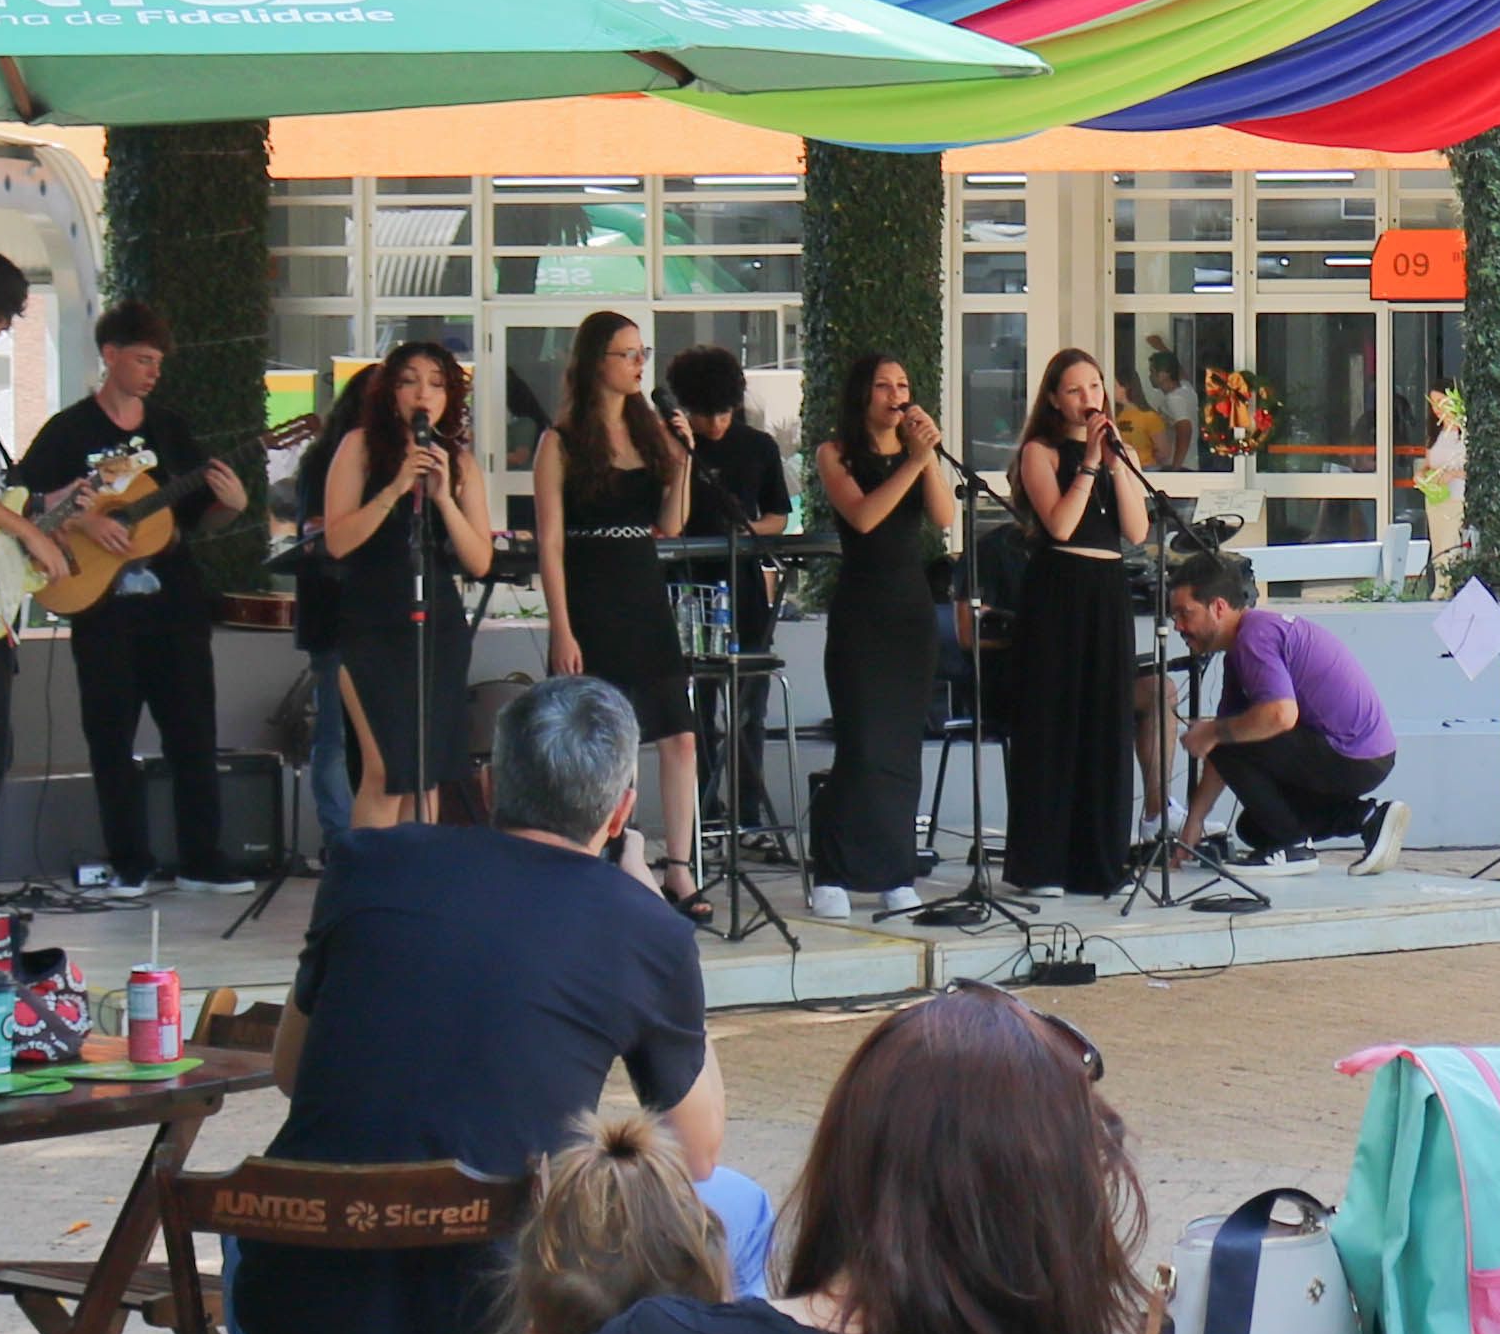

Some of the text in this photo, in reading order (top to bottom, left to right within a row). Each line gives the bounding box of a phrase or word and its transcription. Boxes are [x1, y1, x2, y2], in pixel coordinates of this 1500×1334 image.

[64, 9, 125, 26] de
[136, 7, 396, 26] Fidelidade
[1392, 252, 1430, 277] 09
[213, 1190, 490, 1227] JUNTOS Sicredi
